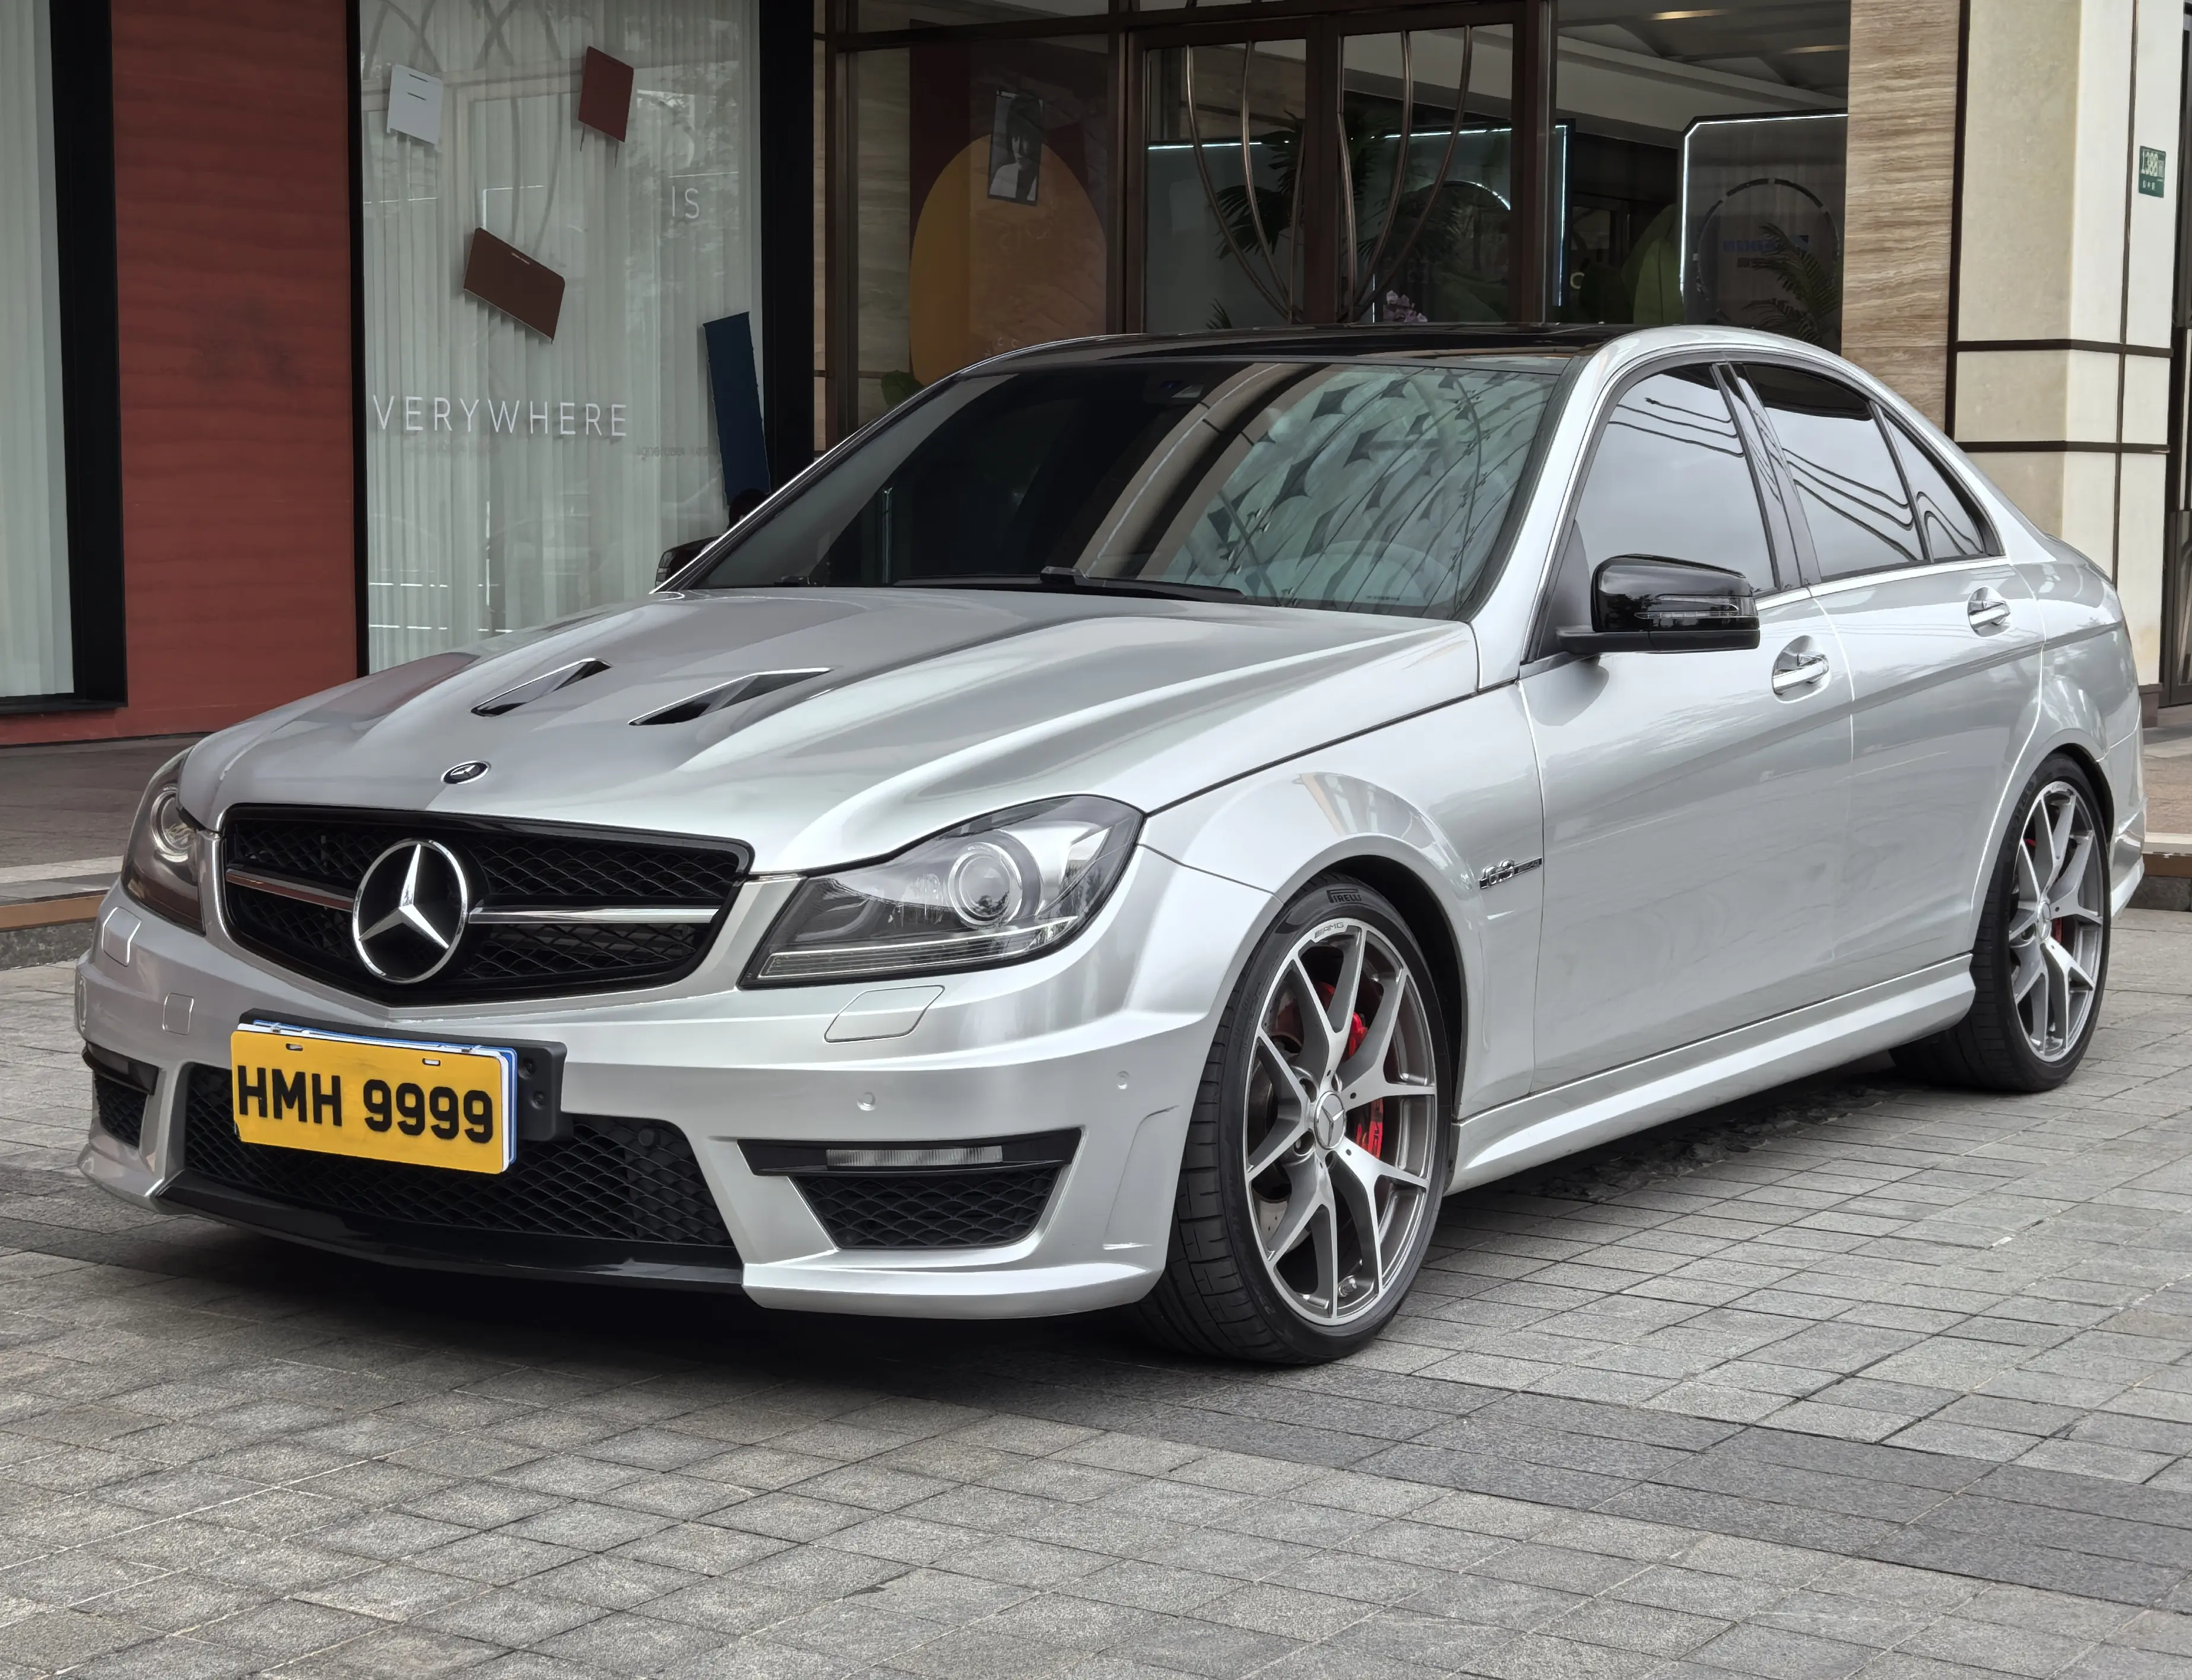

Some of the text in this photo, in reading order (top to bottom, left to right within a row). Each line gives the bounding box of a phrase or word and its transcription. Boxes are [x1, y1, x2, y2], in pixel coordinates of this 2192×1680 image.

[672, 185, 700, 218] IS
[373, 394, 627, 436] VERYWHERE
[1325, 888, 1362, 904] PIRELLI
[1321, 921, 1344, 935] AMG
[237, 1065, 494, 1144] HMH 9999
